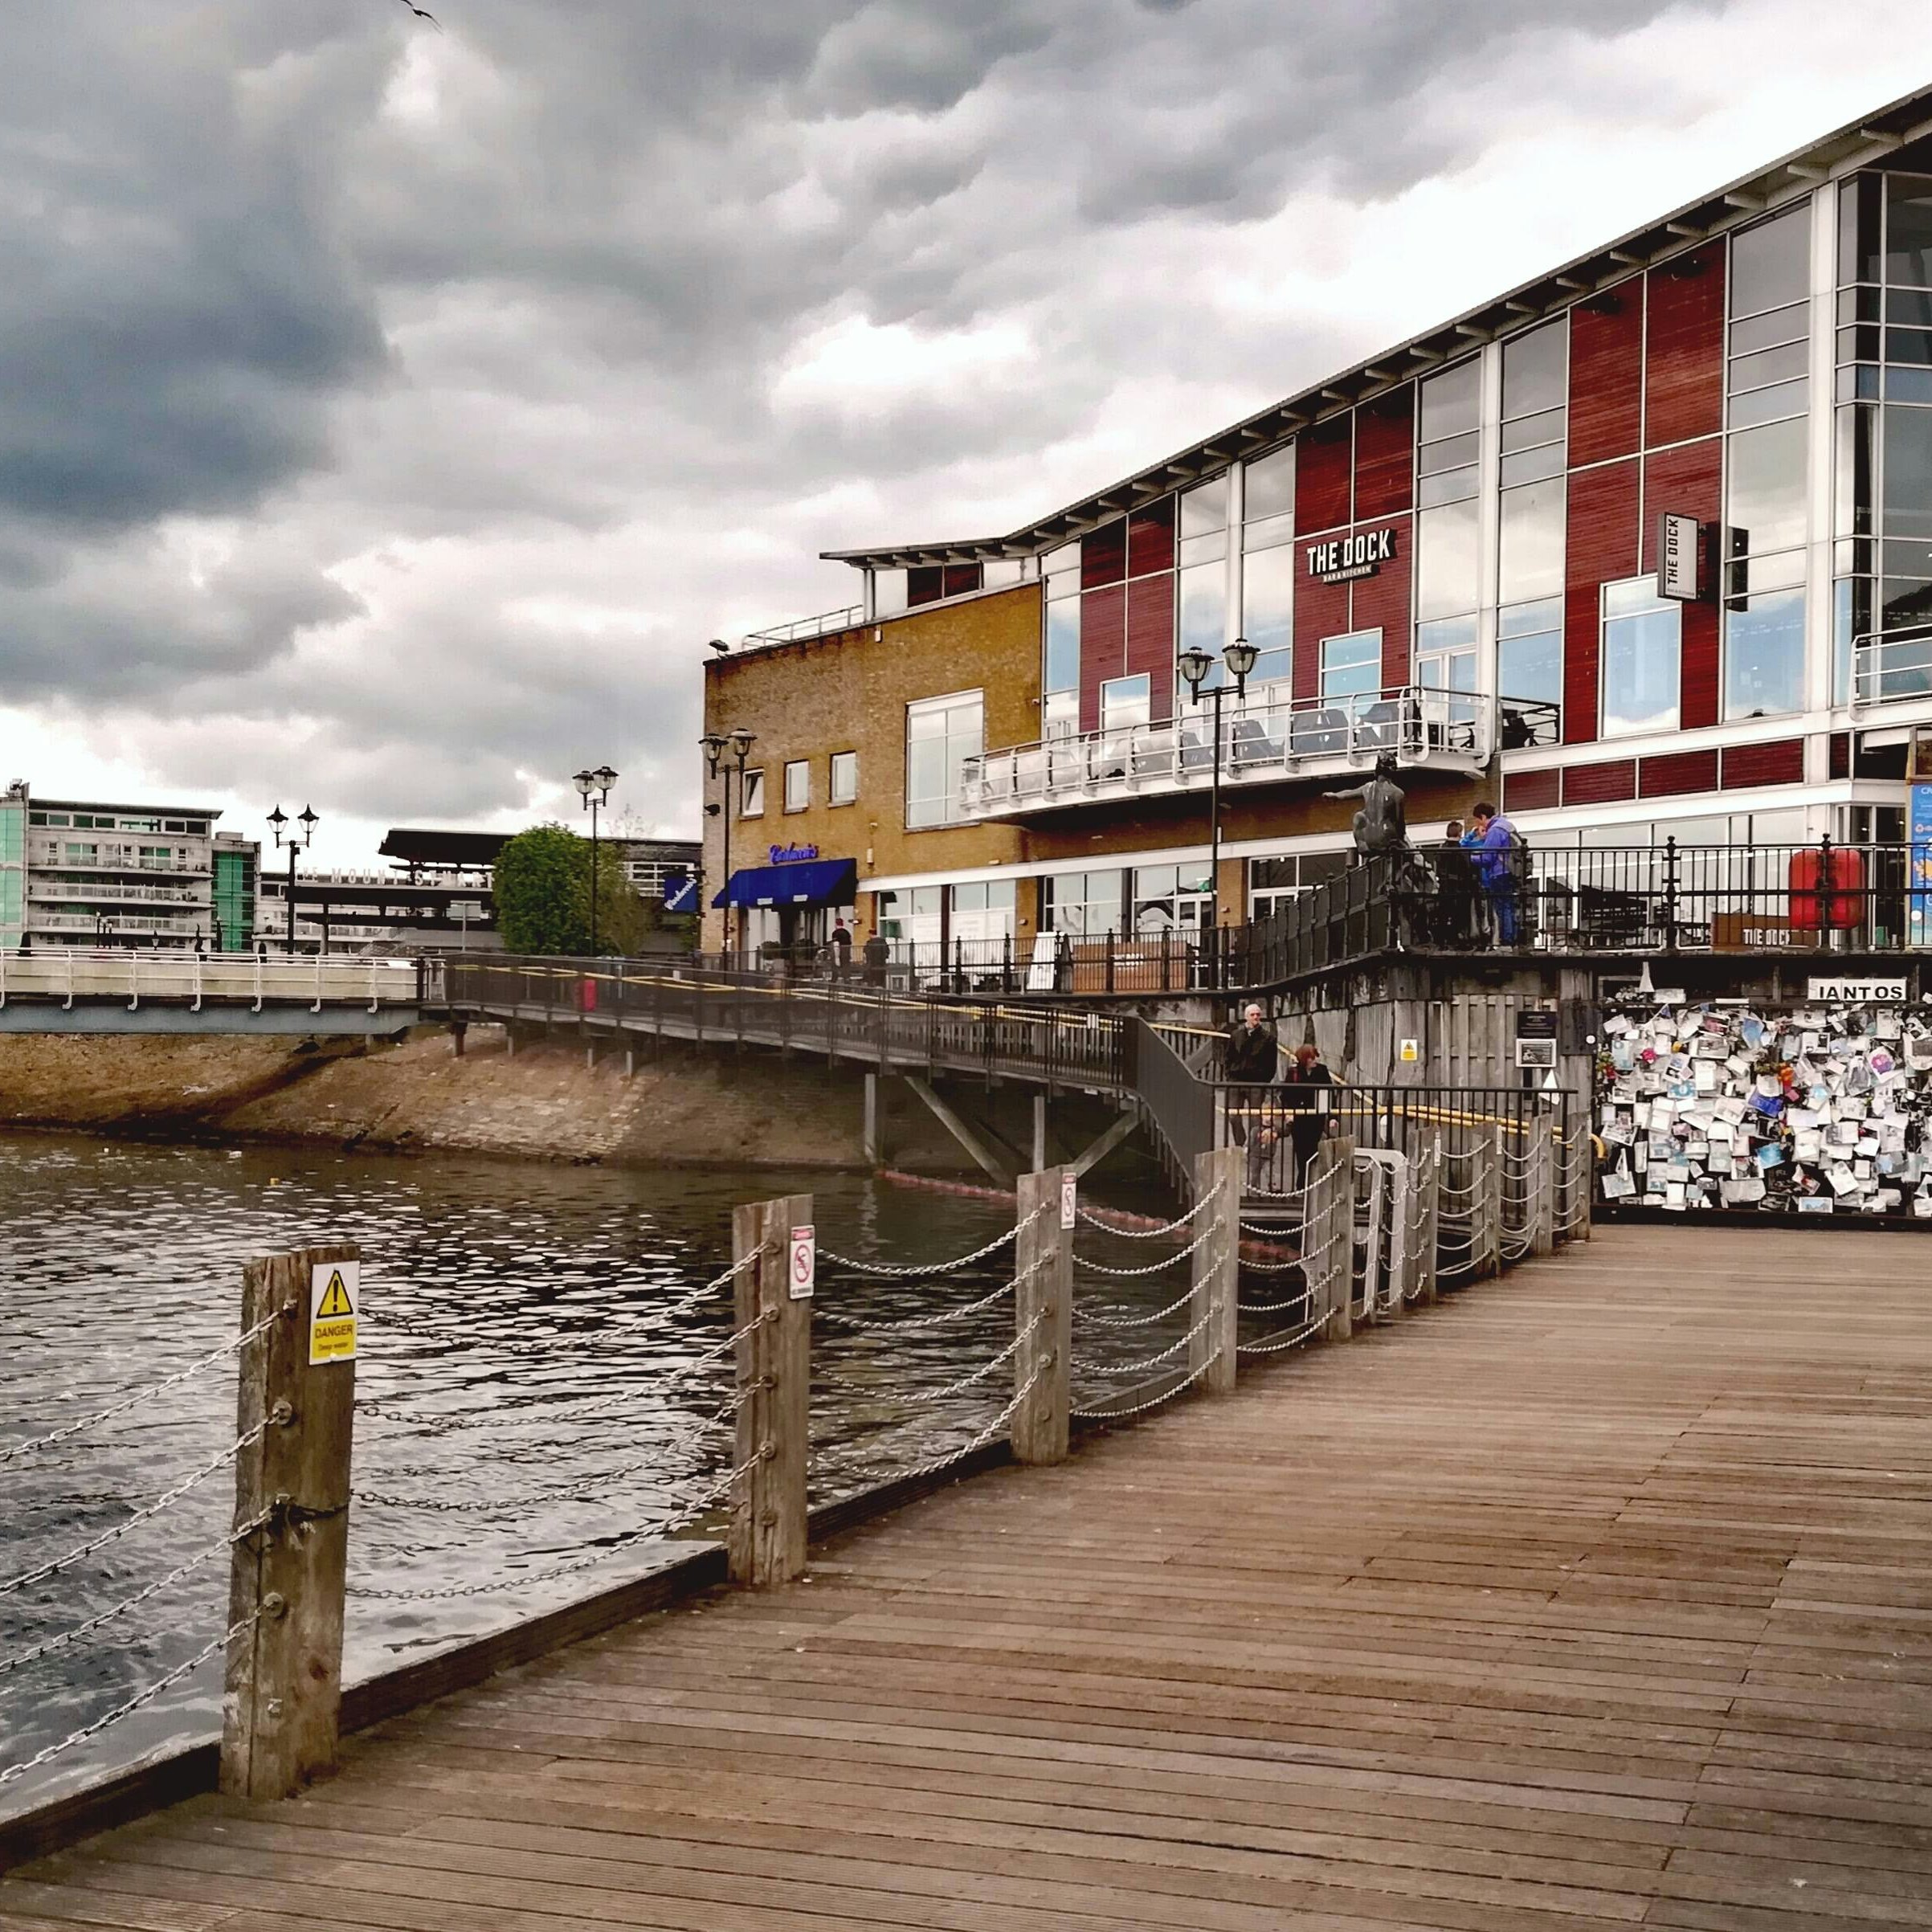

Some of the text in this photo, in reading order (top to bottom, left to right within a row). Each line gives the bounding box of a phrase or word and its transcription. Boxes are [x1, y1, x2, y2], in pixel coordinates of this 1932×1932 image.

[1307, 529, 1391, 575] THE DOCK
[1668, 518, 1678, 586] THE DOCK
[331, 868, 398, 884] MOUNT
[1820, 986, 1902, 999] IANTOS
[315, 1324, 353, 1338] DANGER
